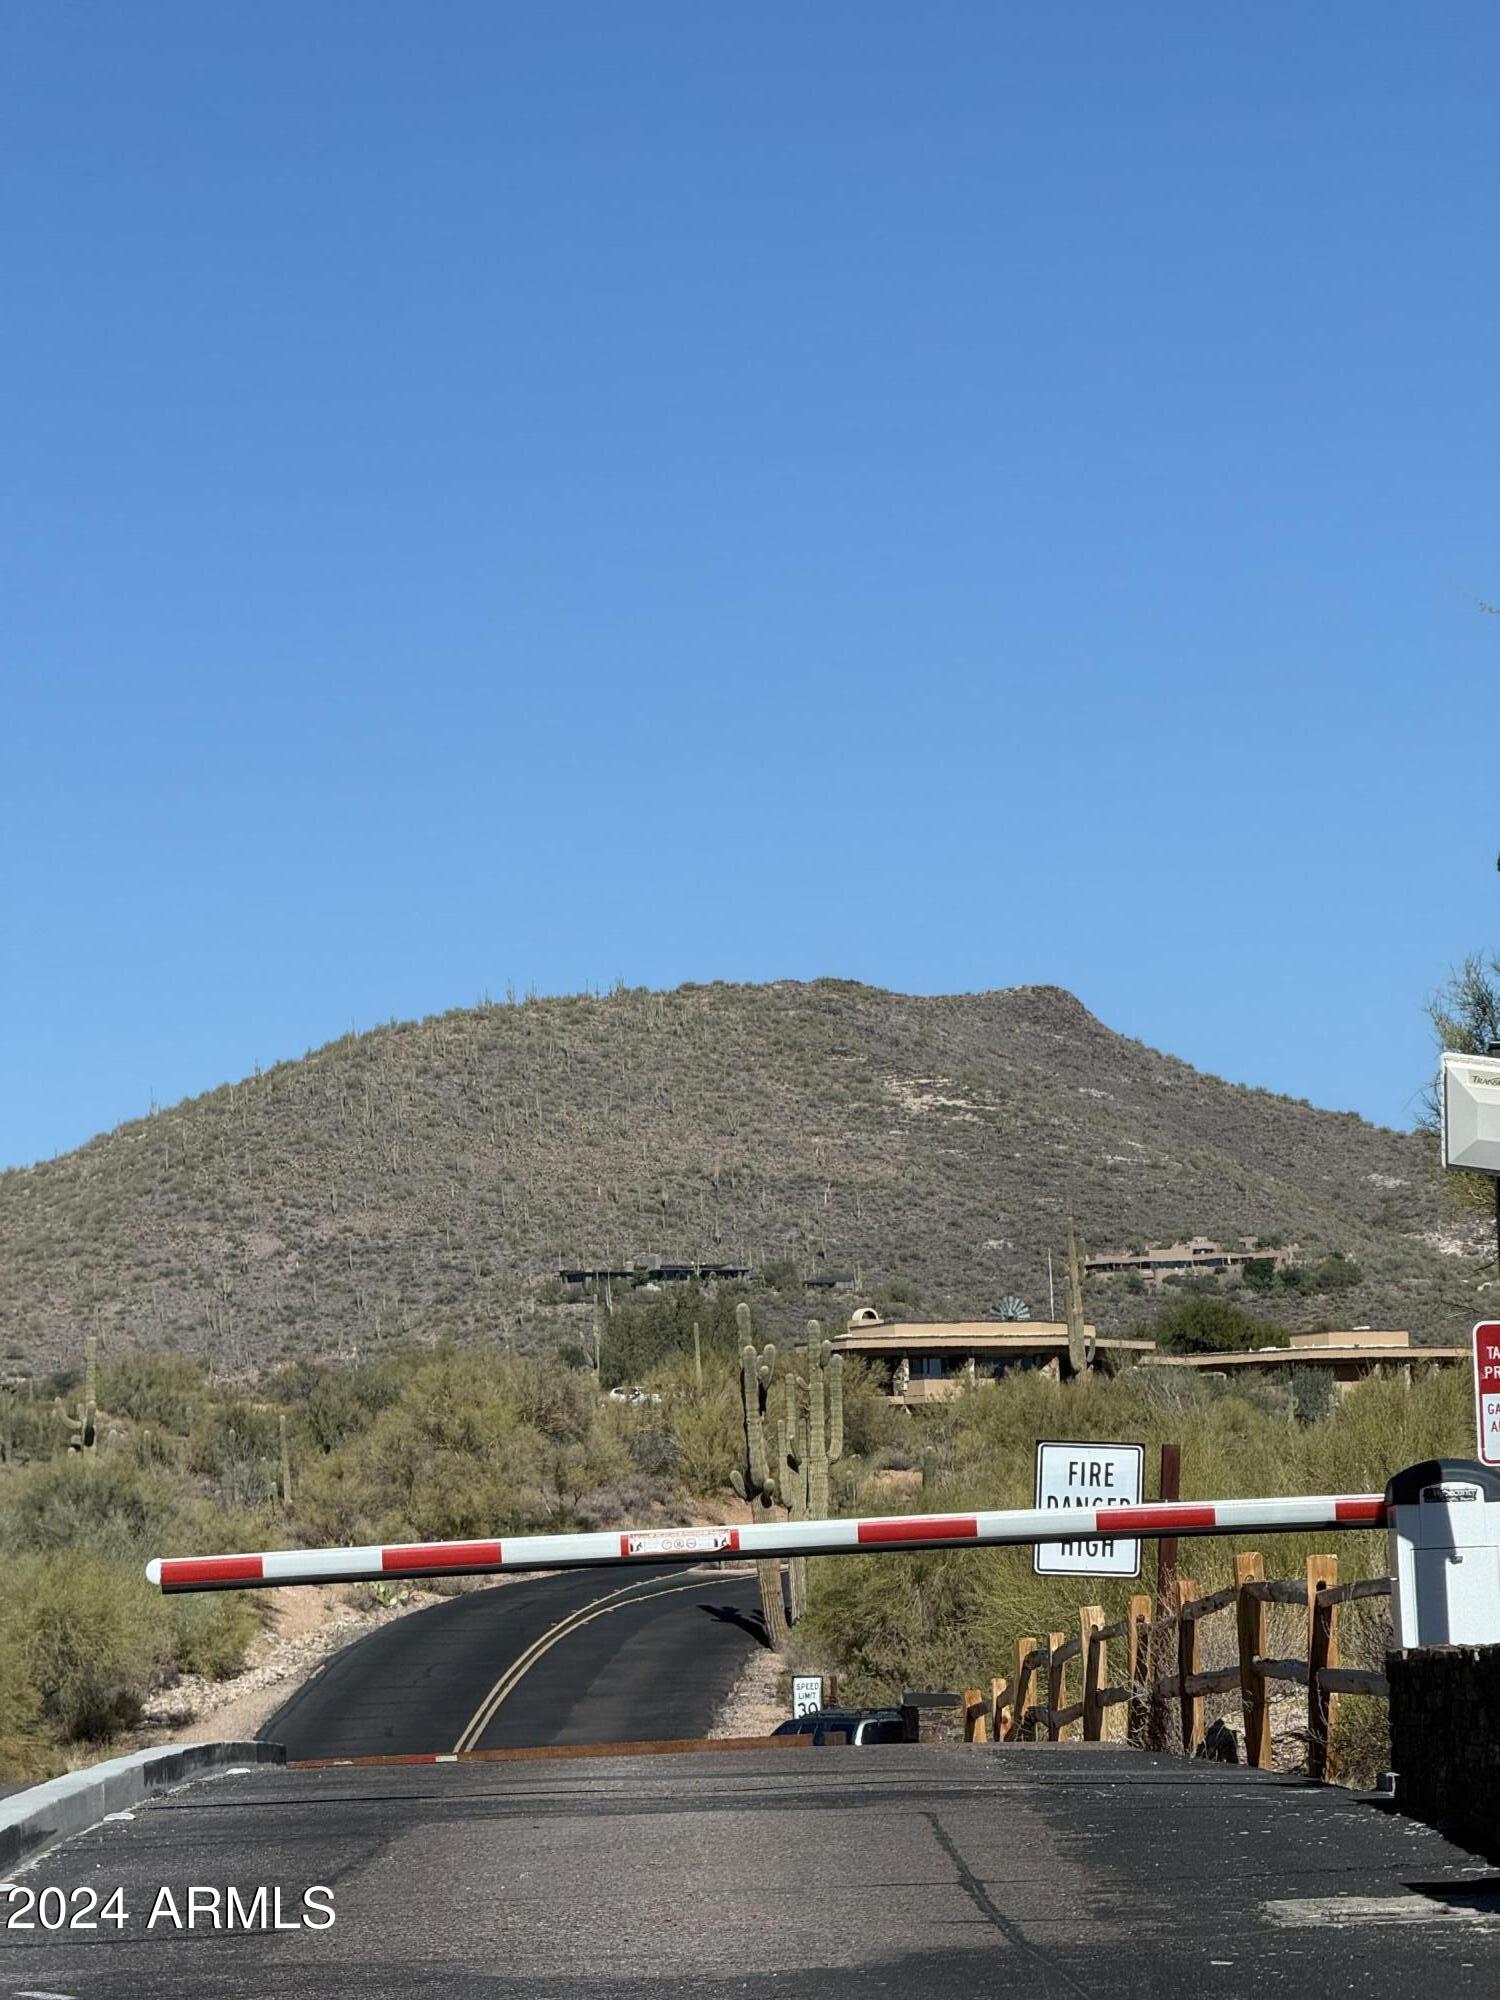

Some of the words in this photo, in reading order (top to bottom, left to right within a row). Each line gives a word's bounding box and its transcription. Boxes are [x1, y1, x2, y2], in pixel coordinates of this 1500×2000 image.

[1472, 1075, 1500, 1087] TRANS
[1484, 1366, 1500, 1379] PR
[1491, 1421, 1500, 1432] A
[1068, 1461, 1115, 1487] FIRE
[1061, 1540, 1114, 1557] HIGH
[796, 1682, 819, 1691] SPEED
[798, 1691, 816, 1700] LIMIT
[798, 1702, 819, 1718] 30
